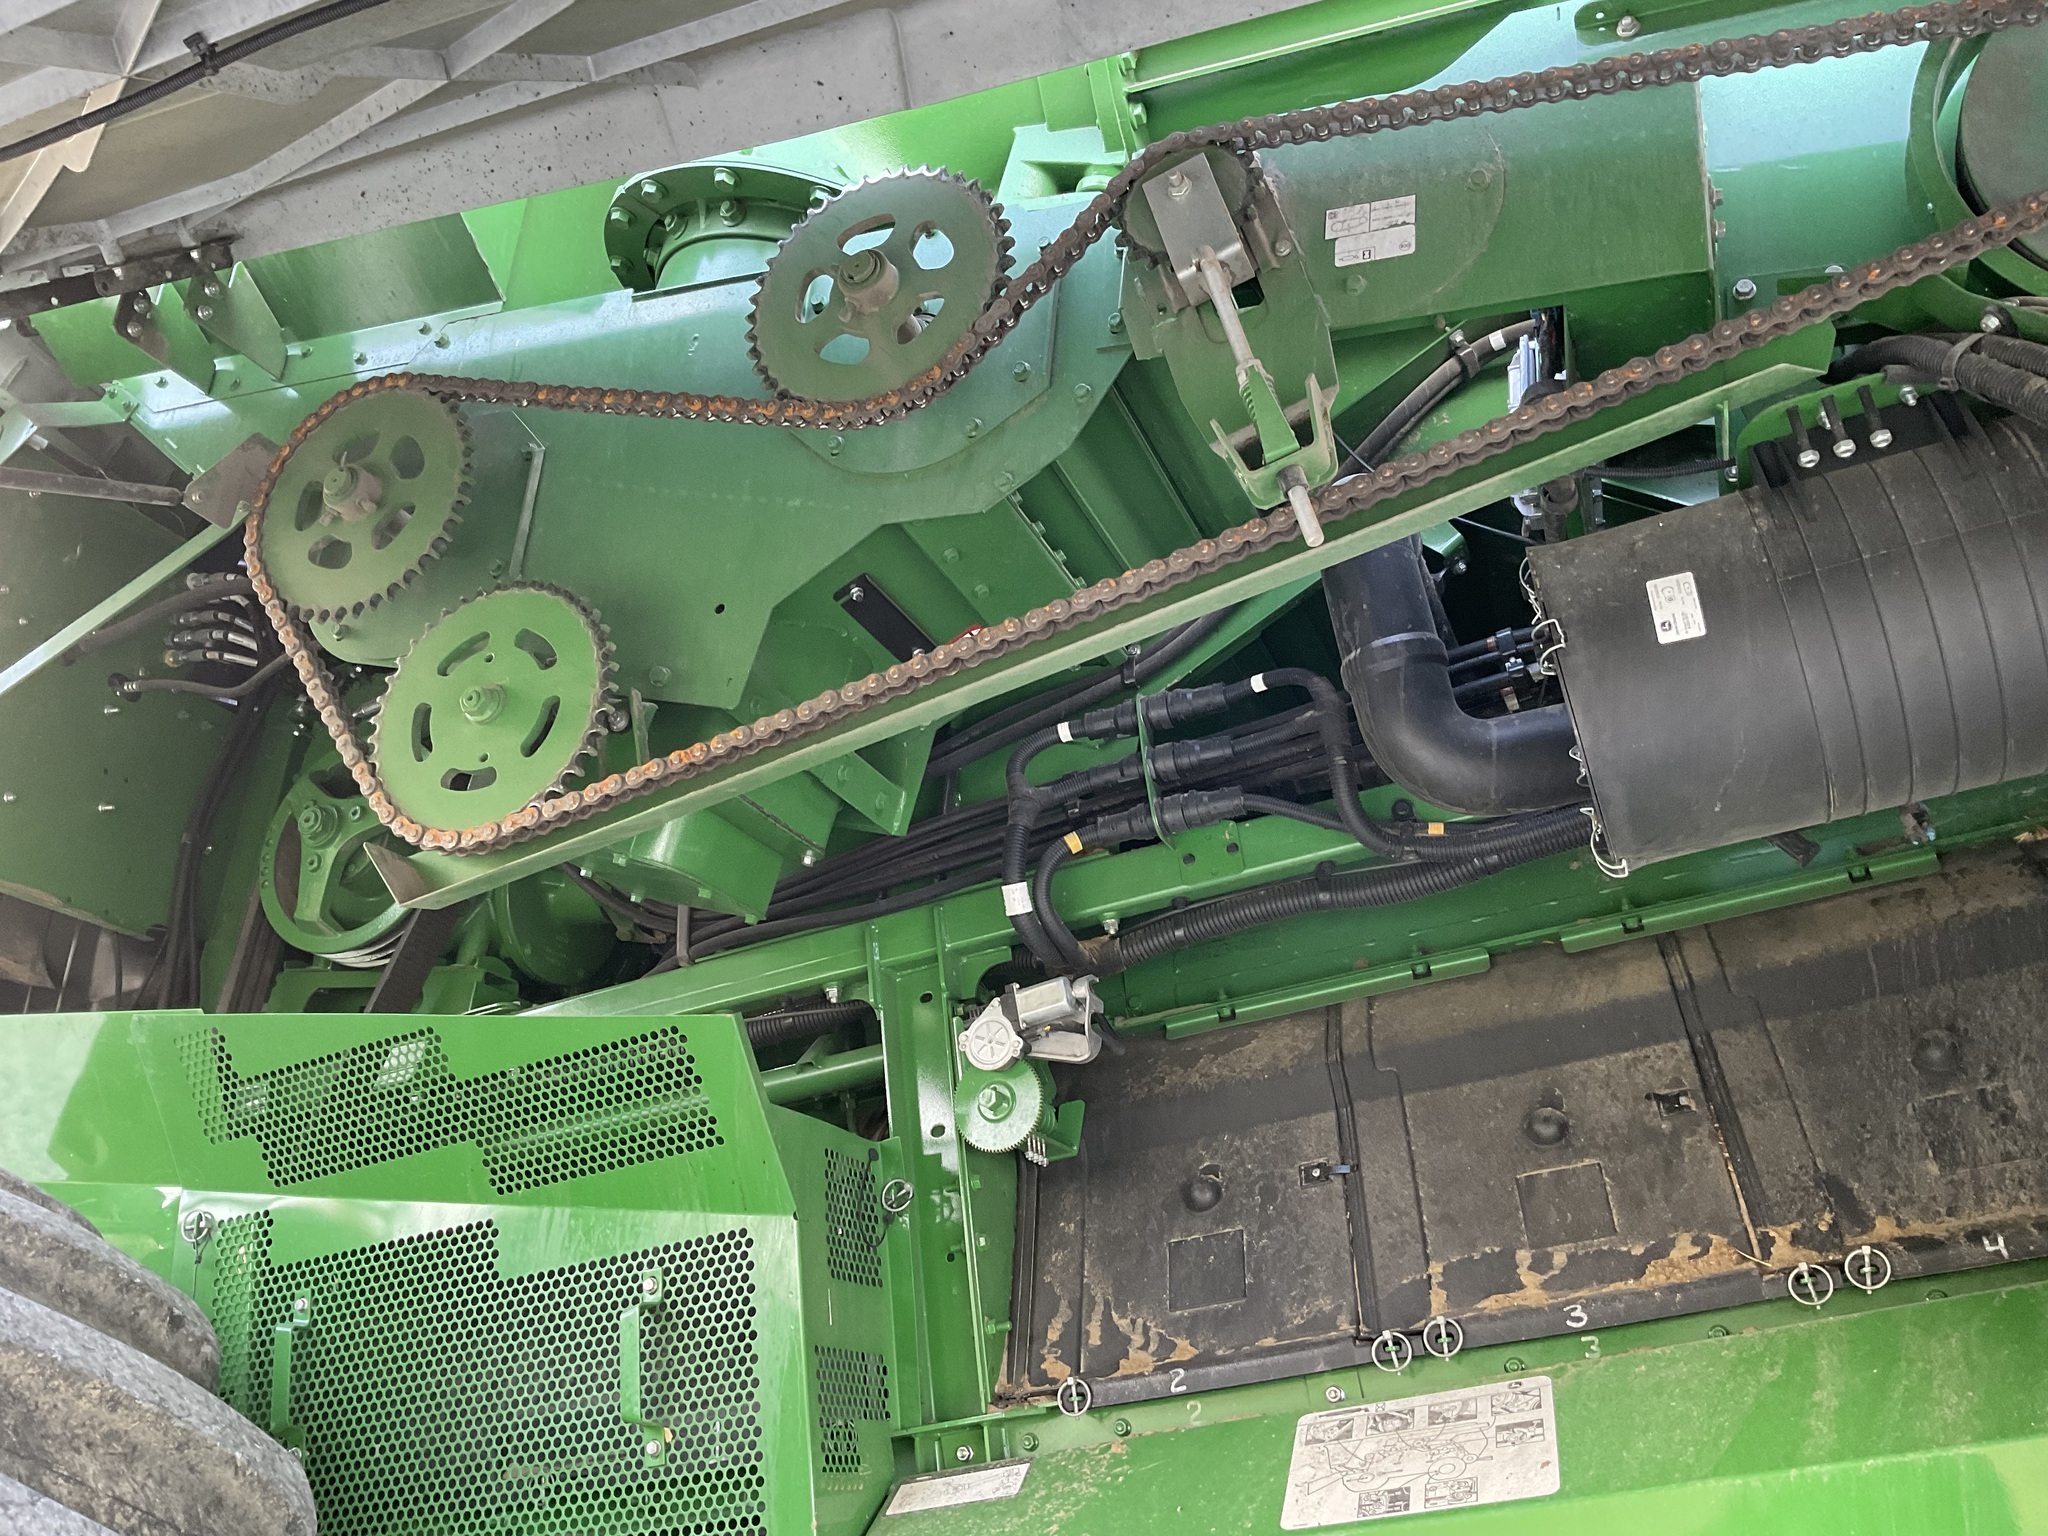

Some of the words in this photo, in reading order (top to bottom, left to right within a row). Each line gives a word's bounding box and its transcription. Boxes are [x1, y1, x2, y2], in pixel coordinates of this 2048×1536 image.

[1982, 1233, 2009, 1259] 4
[1563, 1304, 1588, 1328] 3
[1581, 1336, 1601, 1359] 3
[1169, 1368, 1187, 1393] 2
[1187, 1401, 1206, 1426] 2
